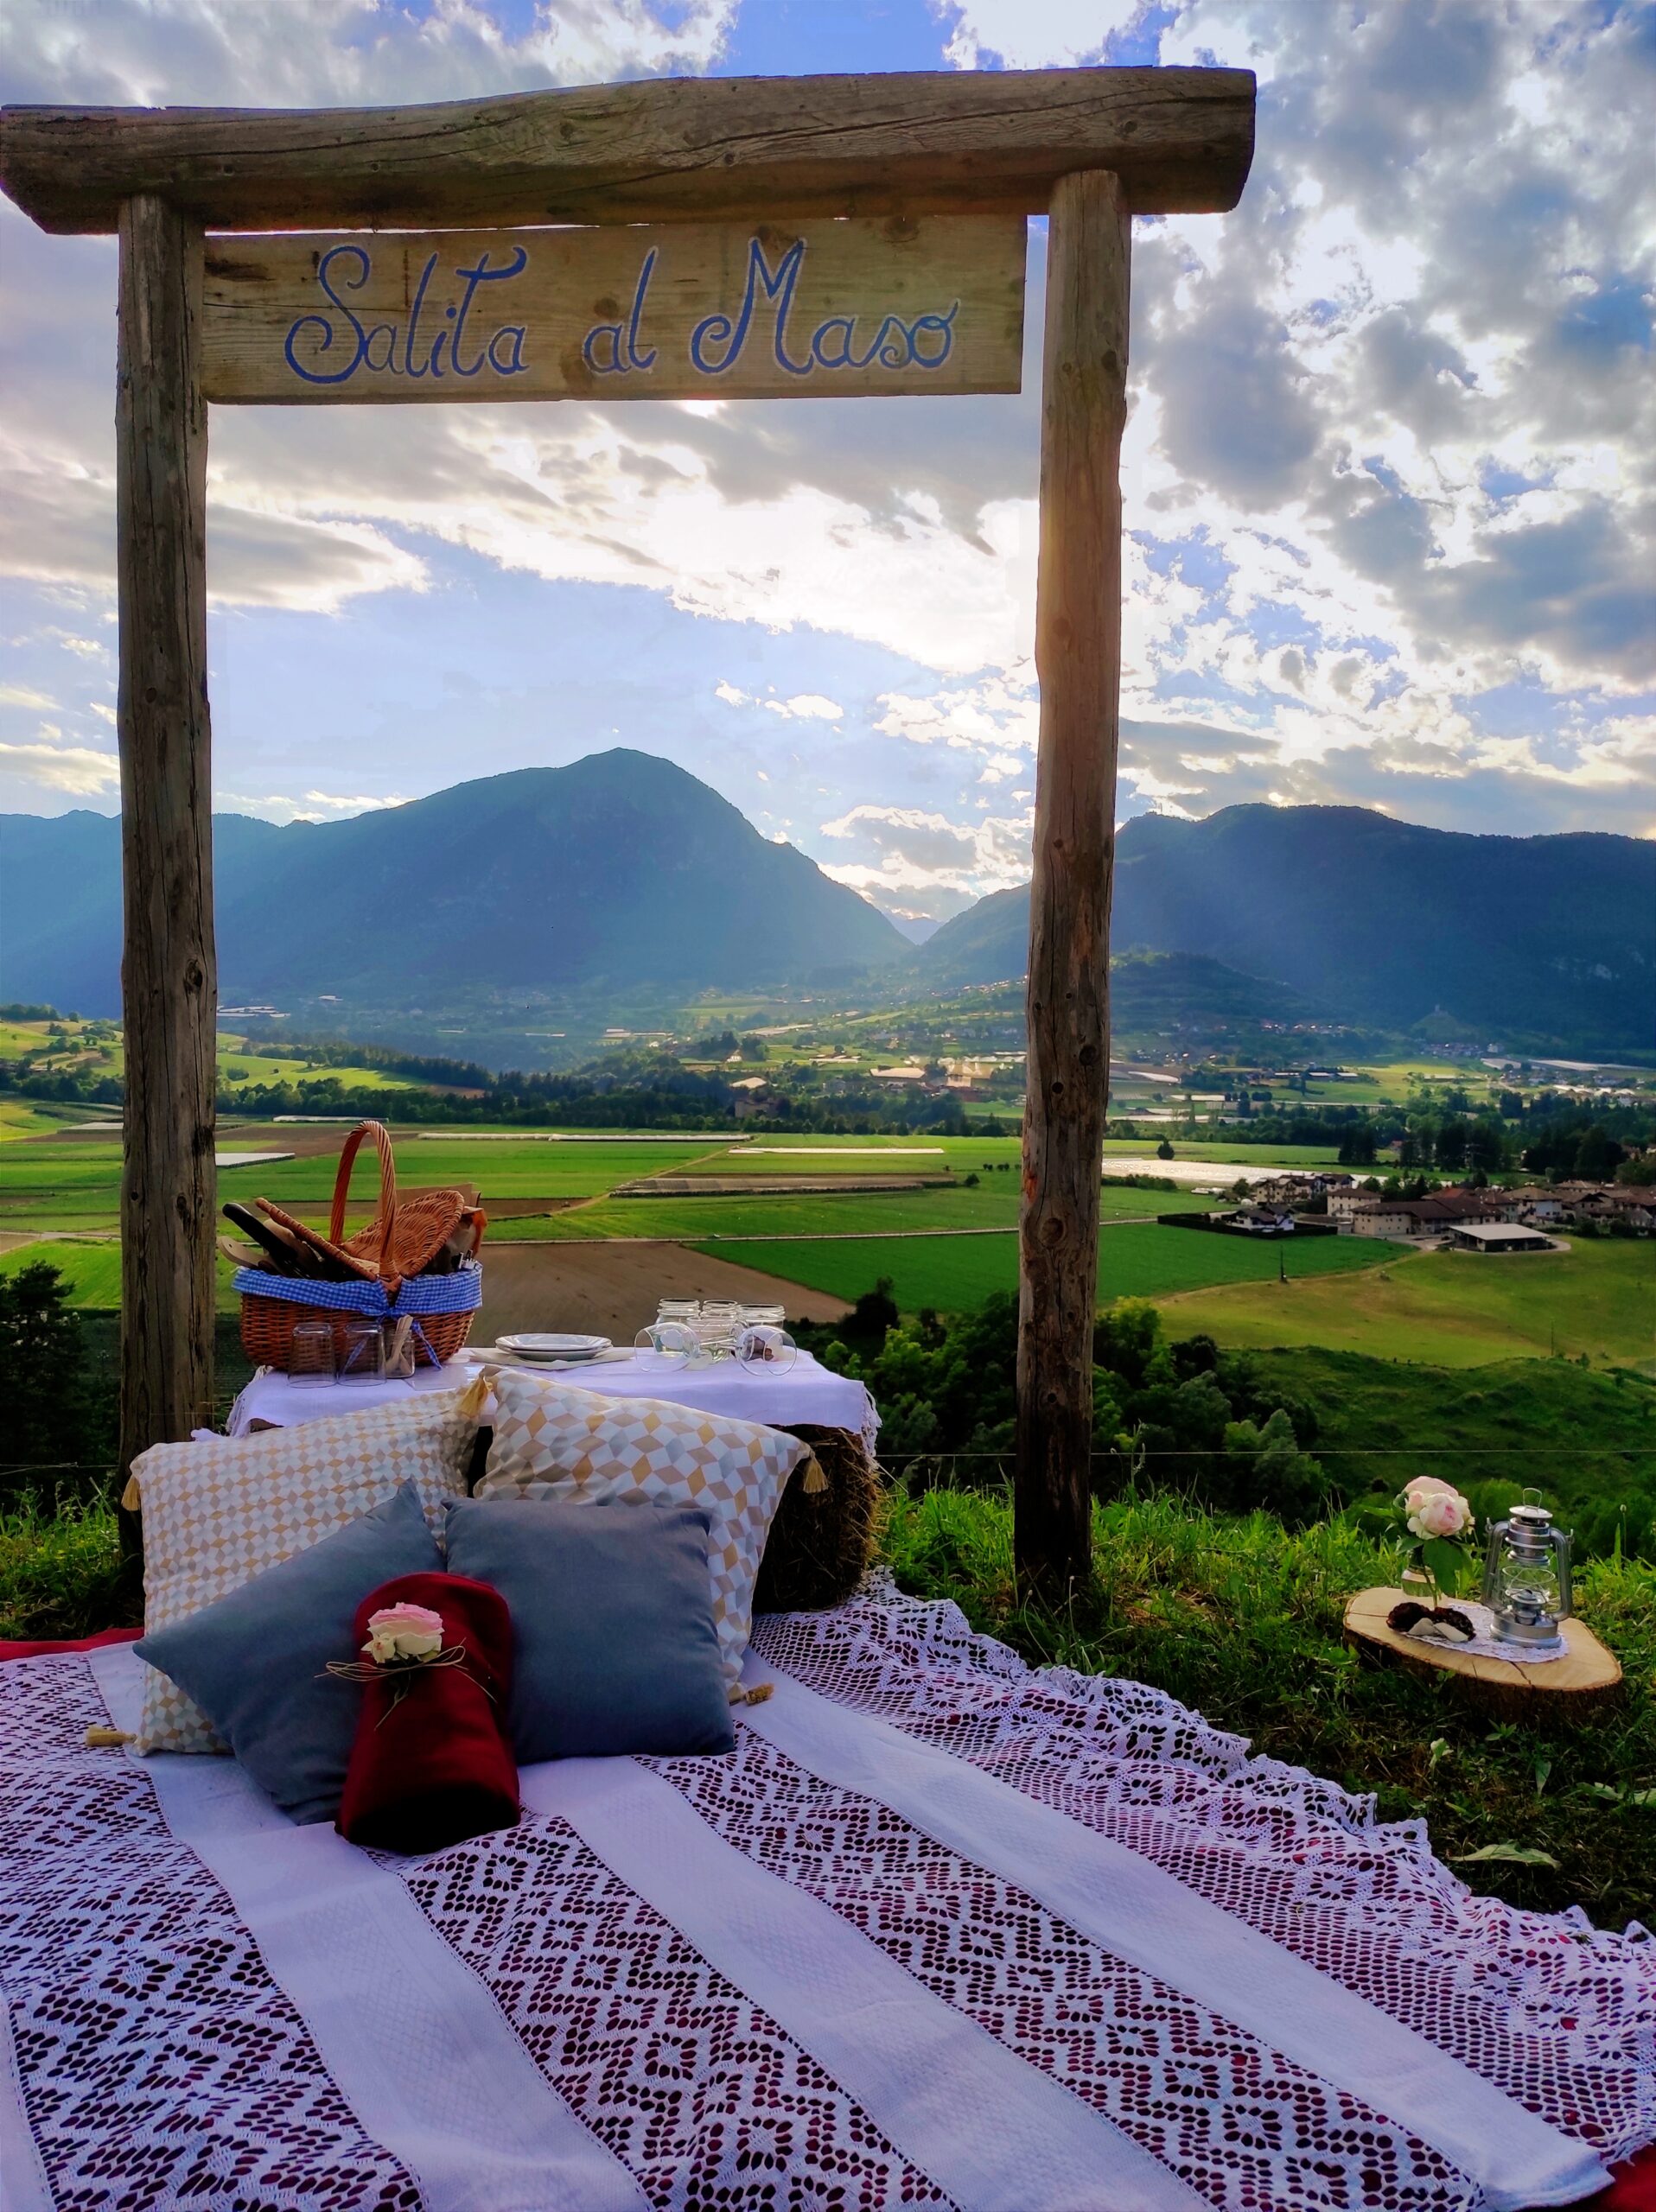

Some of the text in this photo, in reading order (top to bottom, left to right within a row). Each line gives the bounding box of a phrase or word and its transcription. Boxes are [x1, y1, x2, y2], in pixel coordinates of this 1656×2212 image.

[284, 238, 960, 383] Salita al Maso
